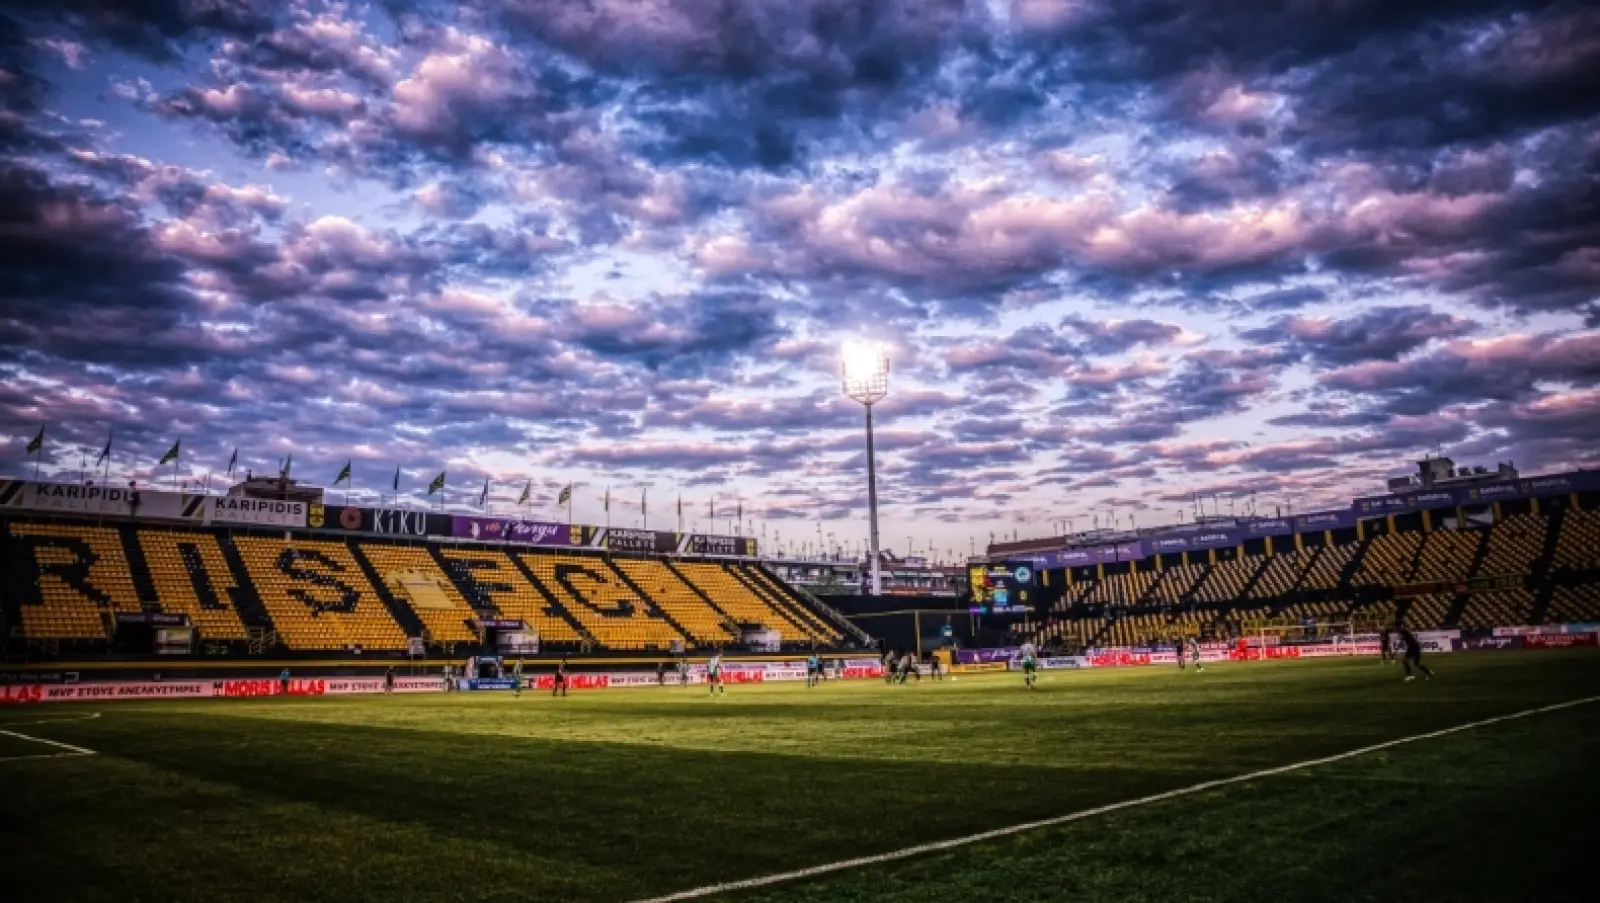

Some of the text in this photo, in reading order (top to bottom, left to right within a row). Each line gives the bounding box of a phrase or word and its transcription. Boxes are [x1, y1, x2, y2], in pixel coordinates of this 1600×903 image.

[215, 498, 302, 515] KARIPIDIS
[225, 679, 324, 697] MORIS HLLAS
